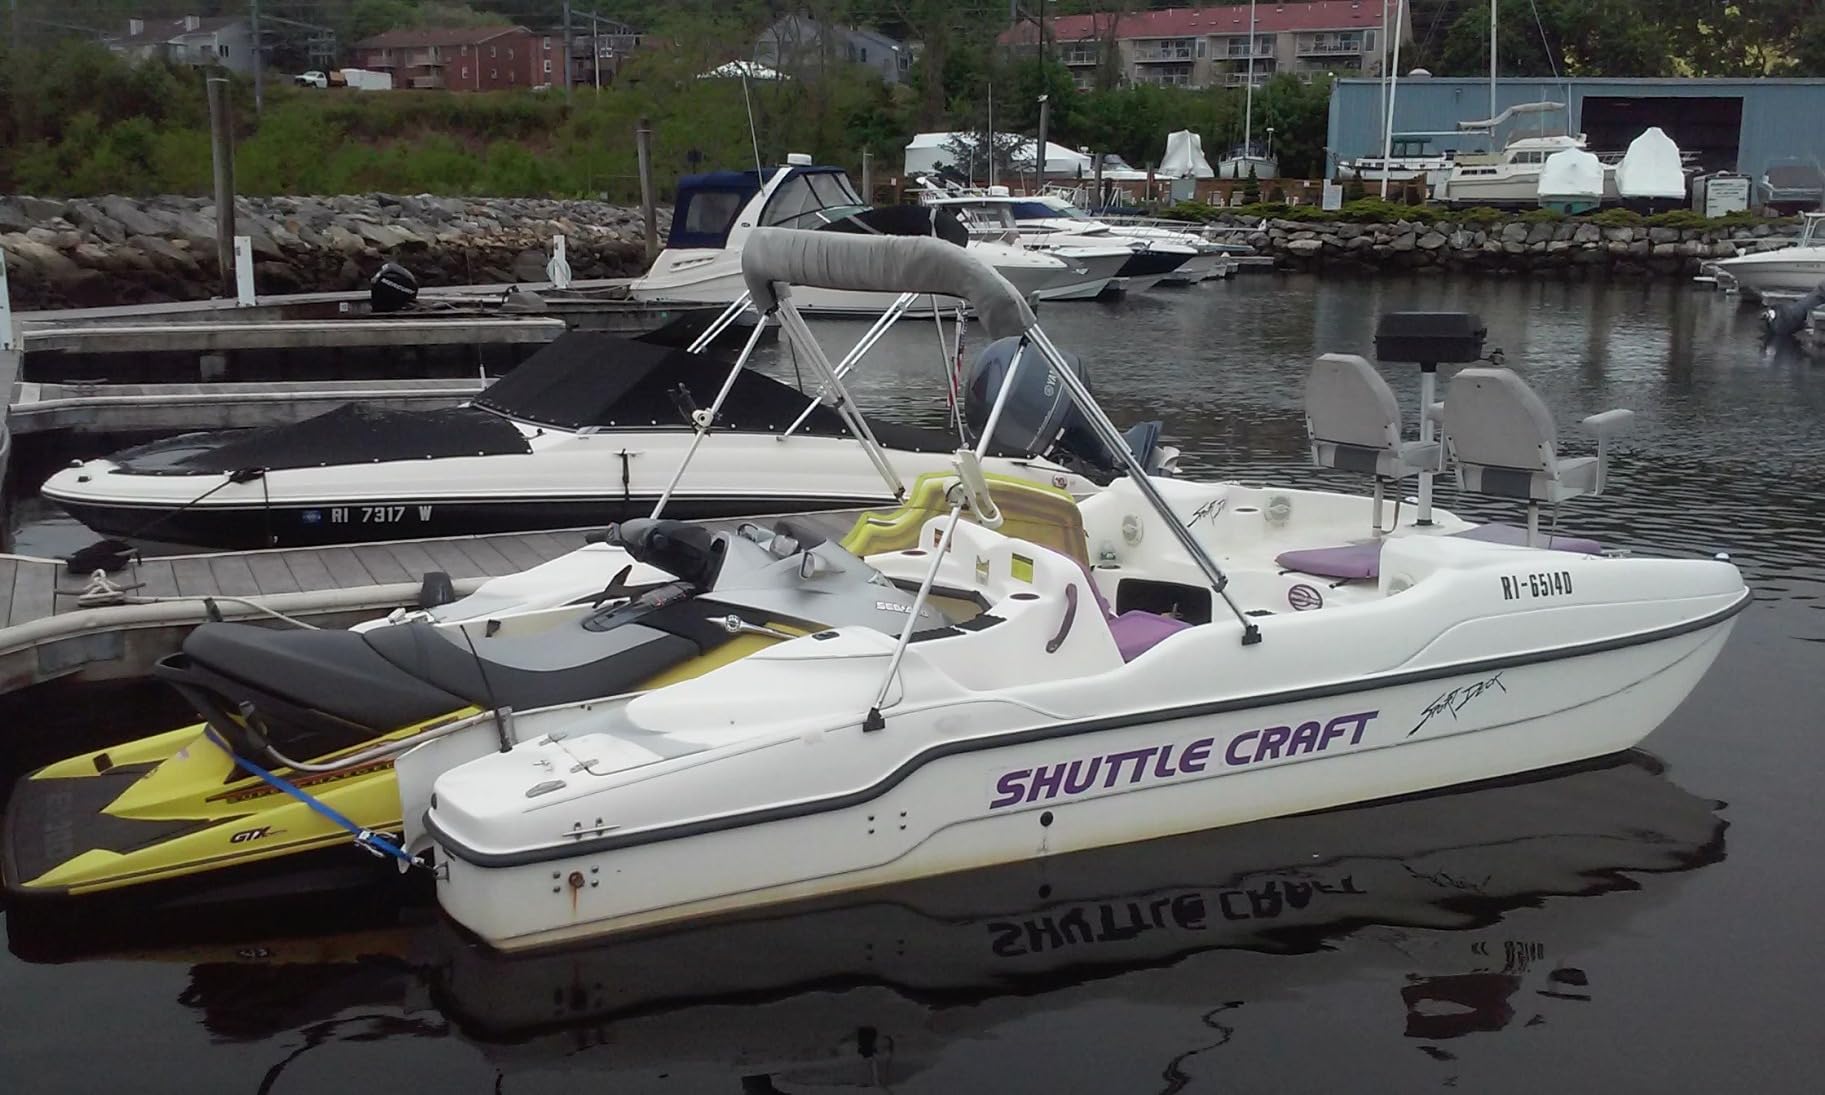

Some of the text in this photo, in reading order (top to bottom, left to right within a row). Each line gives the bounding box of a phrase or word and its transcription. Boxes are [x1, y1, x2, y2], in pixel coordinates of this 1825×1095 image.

[331, 505, 433, 523] RI 7317 W
[1500, 571, 1573, 600] RI-6514D
[989, 710, 1380, 810] SHUTTLE CRAFT
[230, 826, 272, 844] GTX
